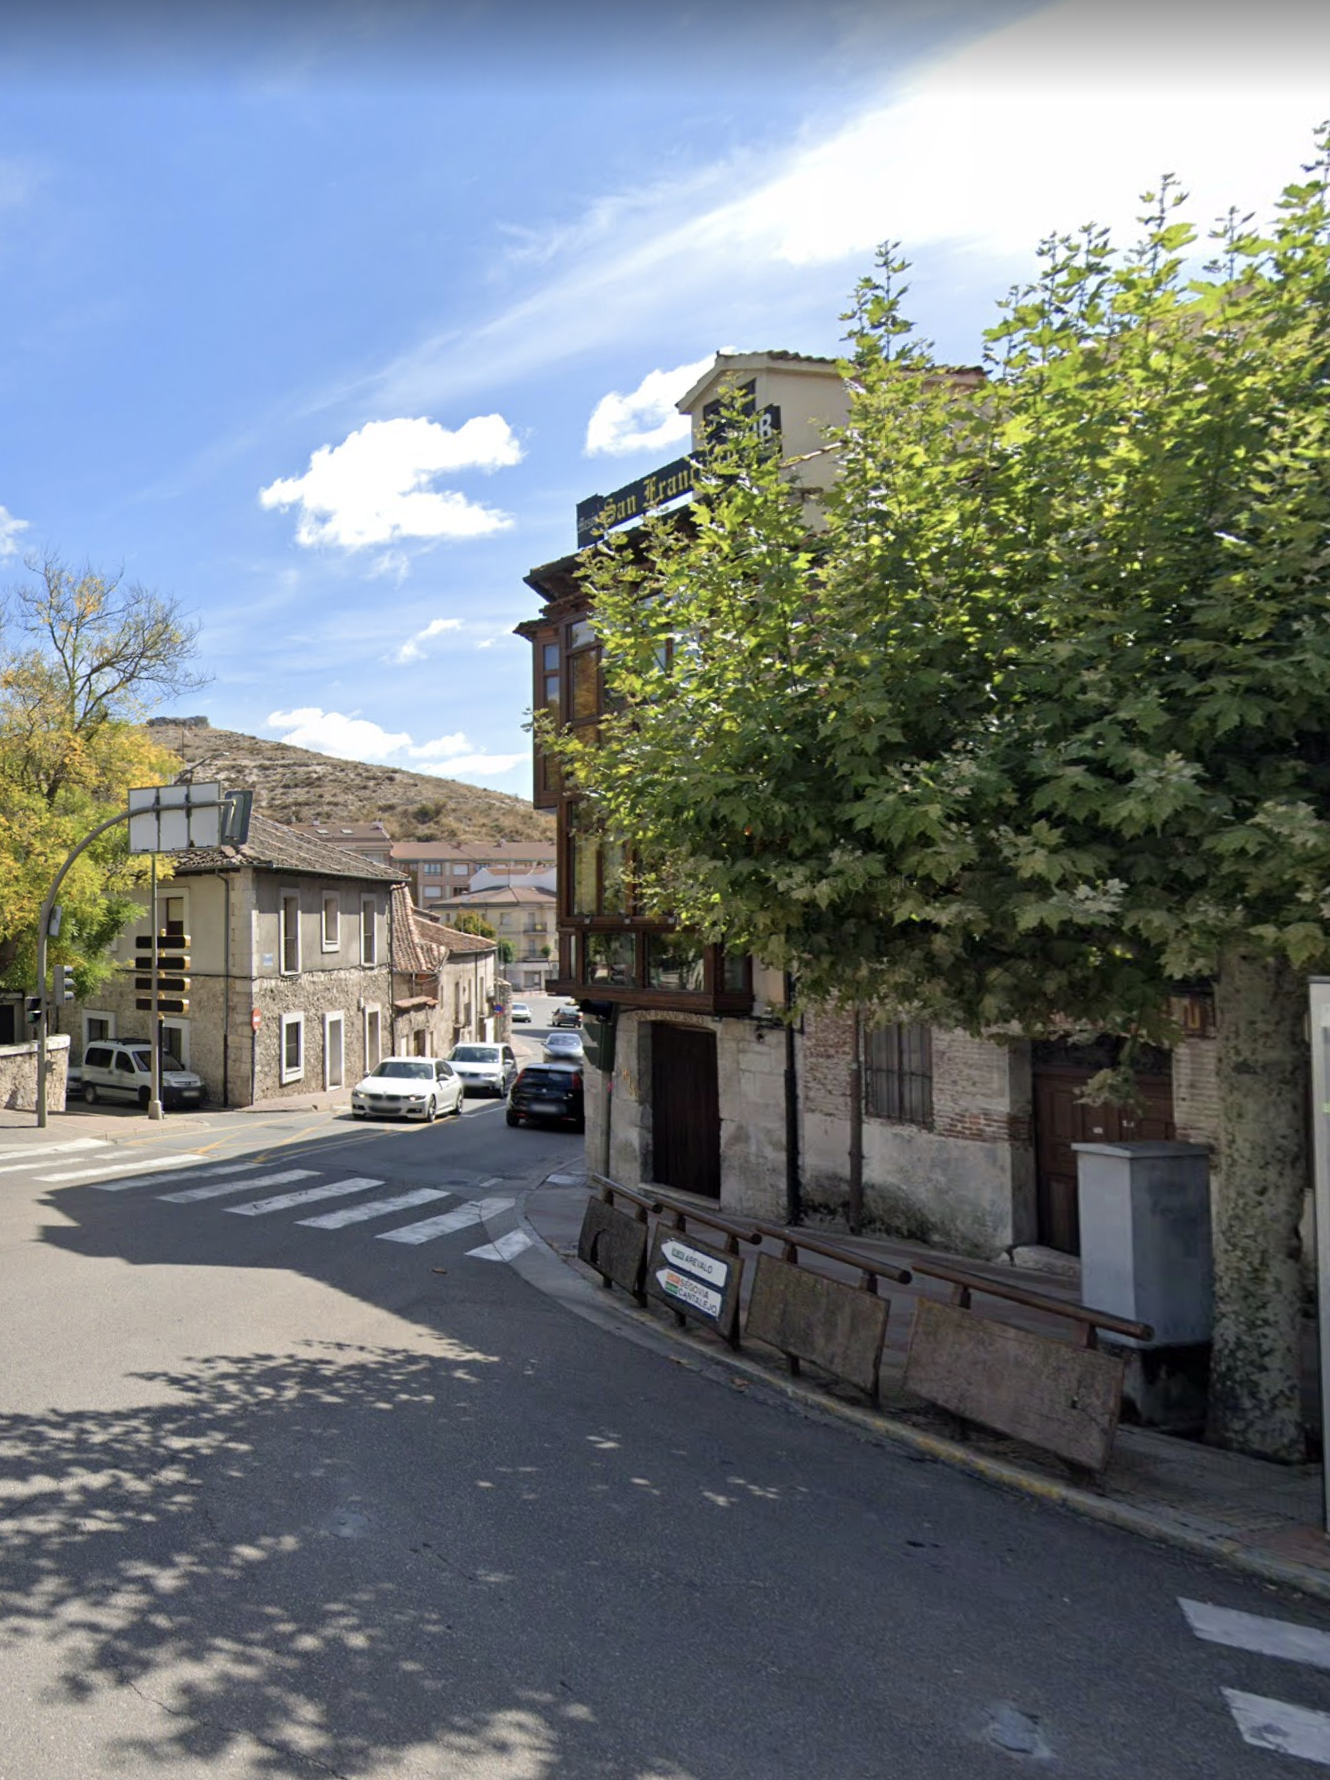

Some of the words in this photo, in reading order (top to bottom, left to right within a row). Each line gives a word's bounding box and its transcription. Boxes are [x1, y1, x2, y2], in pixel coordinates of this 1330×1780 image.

[602, 496, 637, 524] San
[678, 1287, 718, 1314] CANTALEJO
[680, 1278, 709, 1300] SEGOVIA
